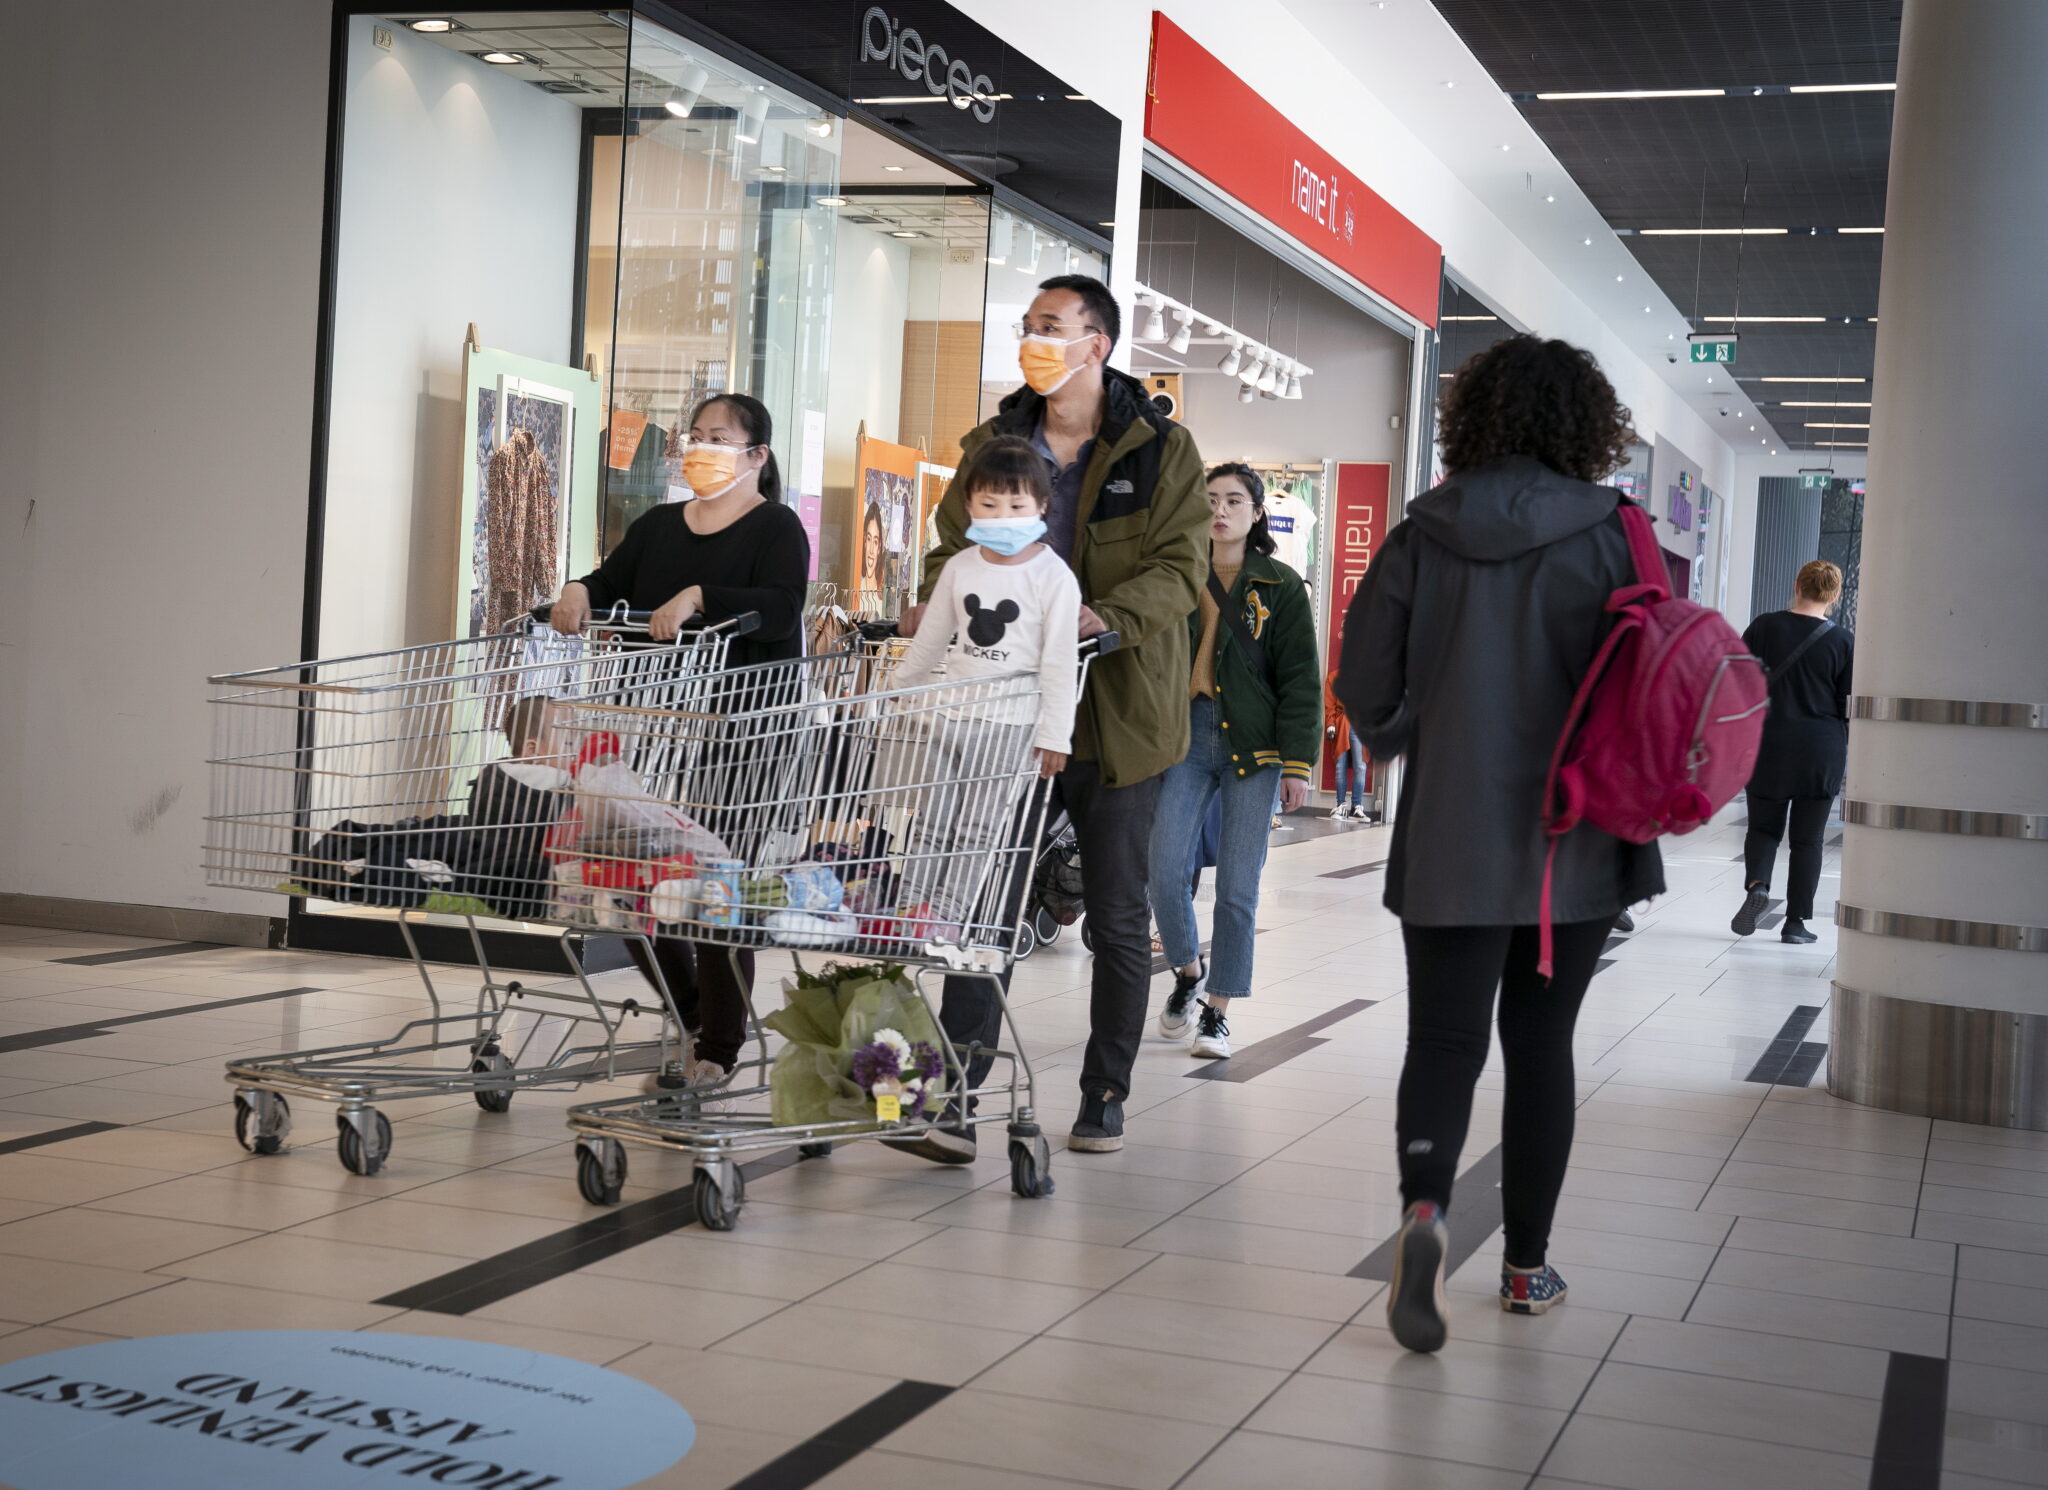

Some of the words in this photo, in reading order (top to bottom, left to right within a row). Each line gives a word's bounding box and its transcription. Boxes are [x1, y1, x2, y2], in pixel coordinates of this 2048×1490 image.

[861, 6, 995, 123] pieces
[1292, 159, 1326, 226] name
[1329, 174, 1338, 234] it
[0, 1373, 329, 1453] VENLIGST
[175, 1373, 516, 1445] AFSTAND
[342, 1443, 563, 1490] HOLD
